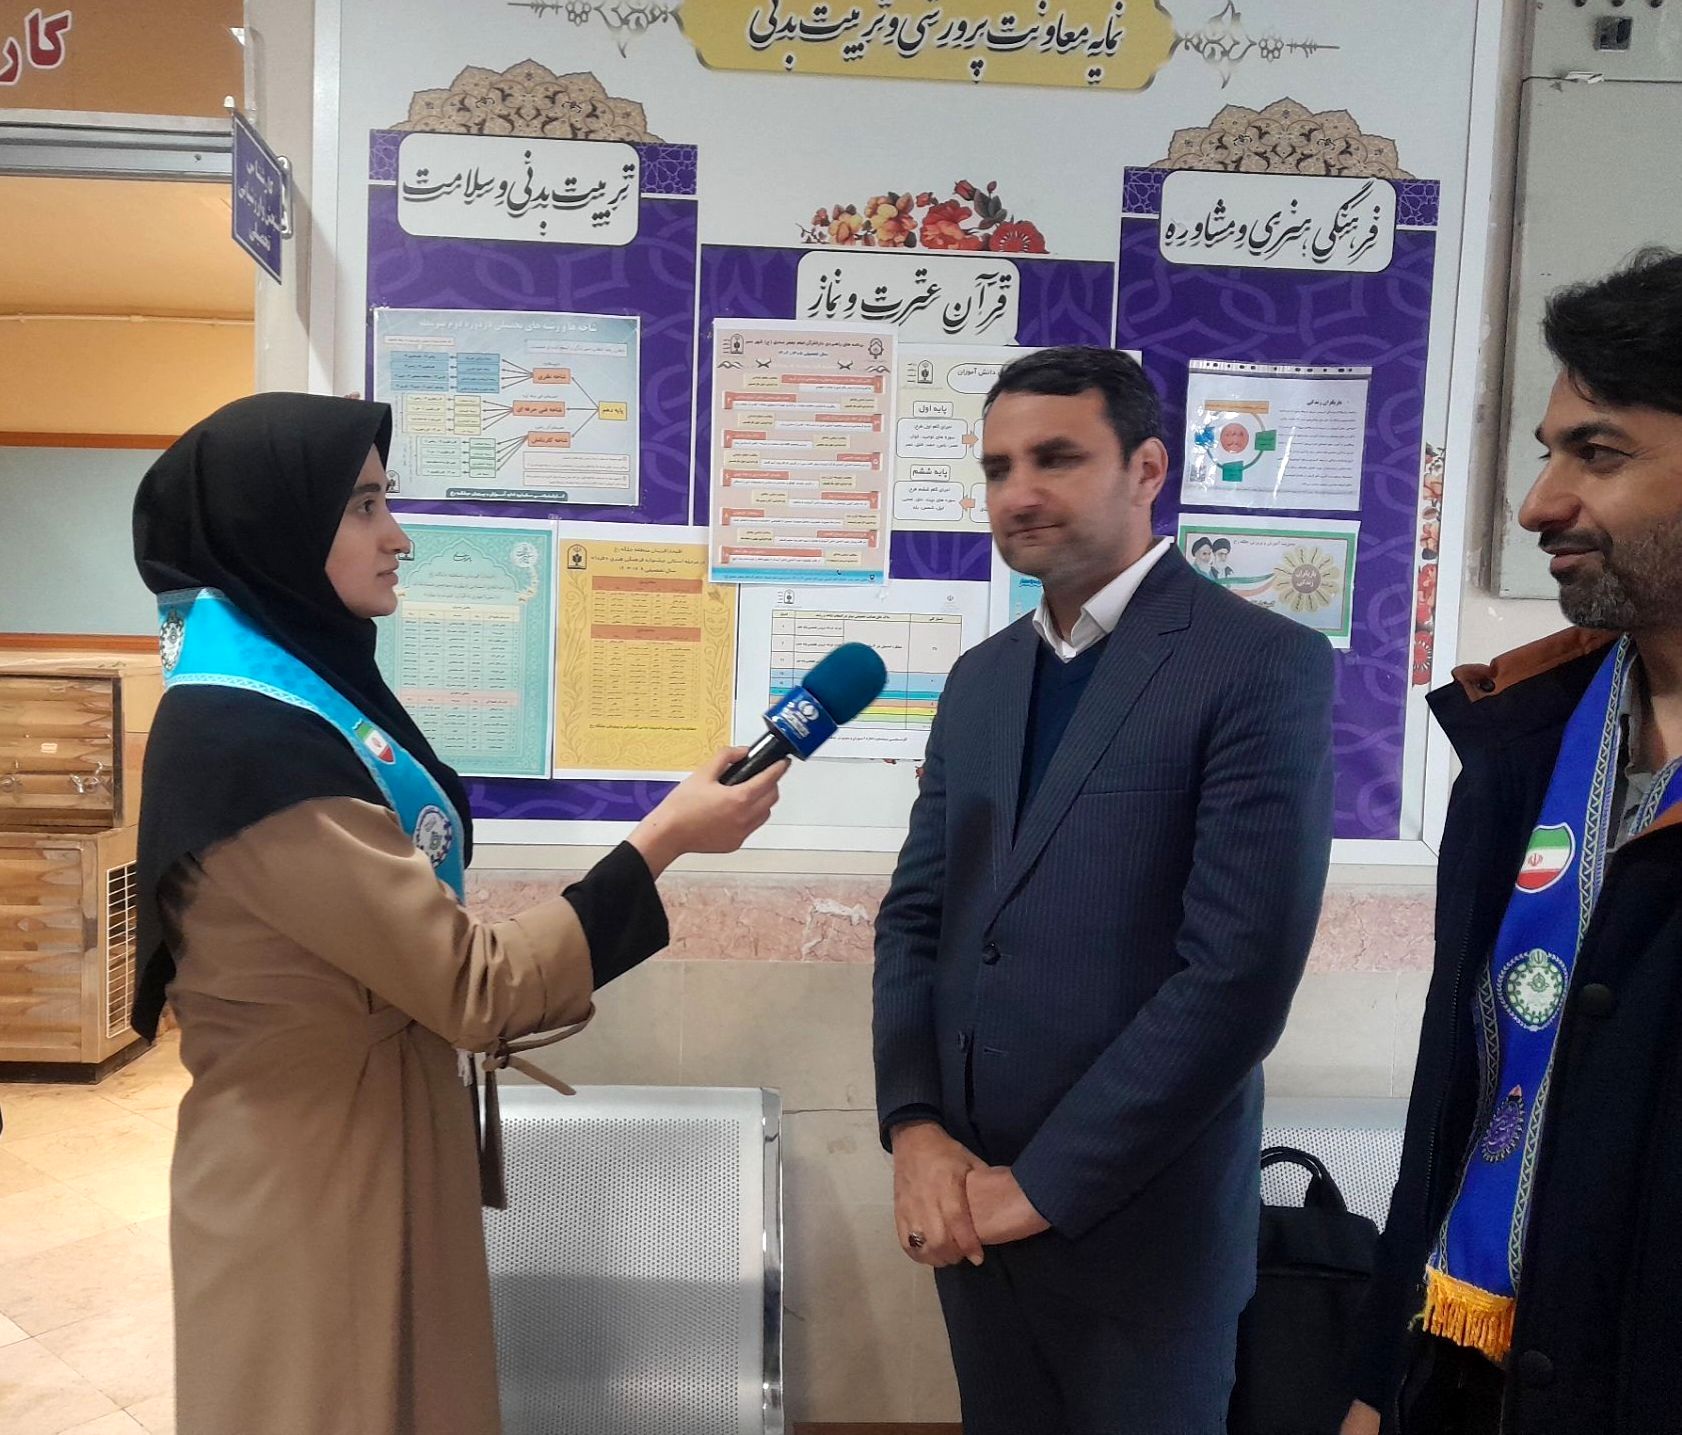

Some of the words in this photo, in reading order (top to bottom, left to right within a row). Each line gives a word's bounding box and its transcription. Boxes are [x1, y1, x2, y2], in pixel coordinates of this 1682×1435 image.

[749, 0, 798, 71] بدنی
[799, 0, 888, 62] تربیت
[883, 15, 901, 45] و
[898, 0, 989, 84] پرورشی
[986, 0, 1089, 54] معاونت
[1086, 0, 1124, 85] نمایه
[402, 166, 496, 206] سلامت
[494, 179, 508, 206] و
[506, 149, 551, 236] بدنی
[551, 162, 635, 228] تربیت
[1164, 198, 1236, 249] مشاوره
[1233, 223, 1248, 249] و
[1248, 198, 1312, 260] هنری
[1311, 178, 1380, 265] فرهنگی
[807, 268, 842, 319] نماز
[843, 292, 858, 319] و
[860, 267, 942, 327] عترت
[943, 271, 1012, 335] قرآن
[918, 404, 932, 414] اول
[934, 404, 948, 415] پایه
[912, 466, 933, 477] ششم
[934, 467, 948, 478] پایه
